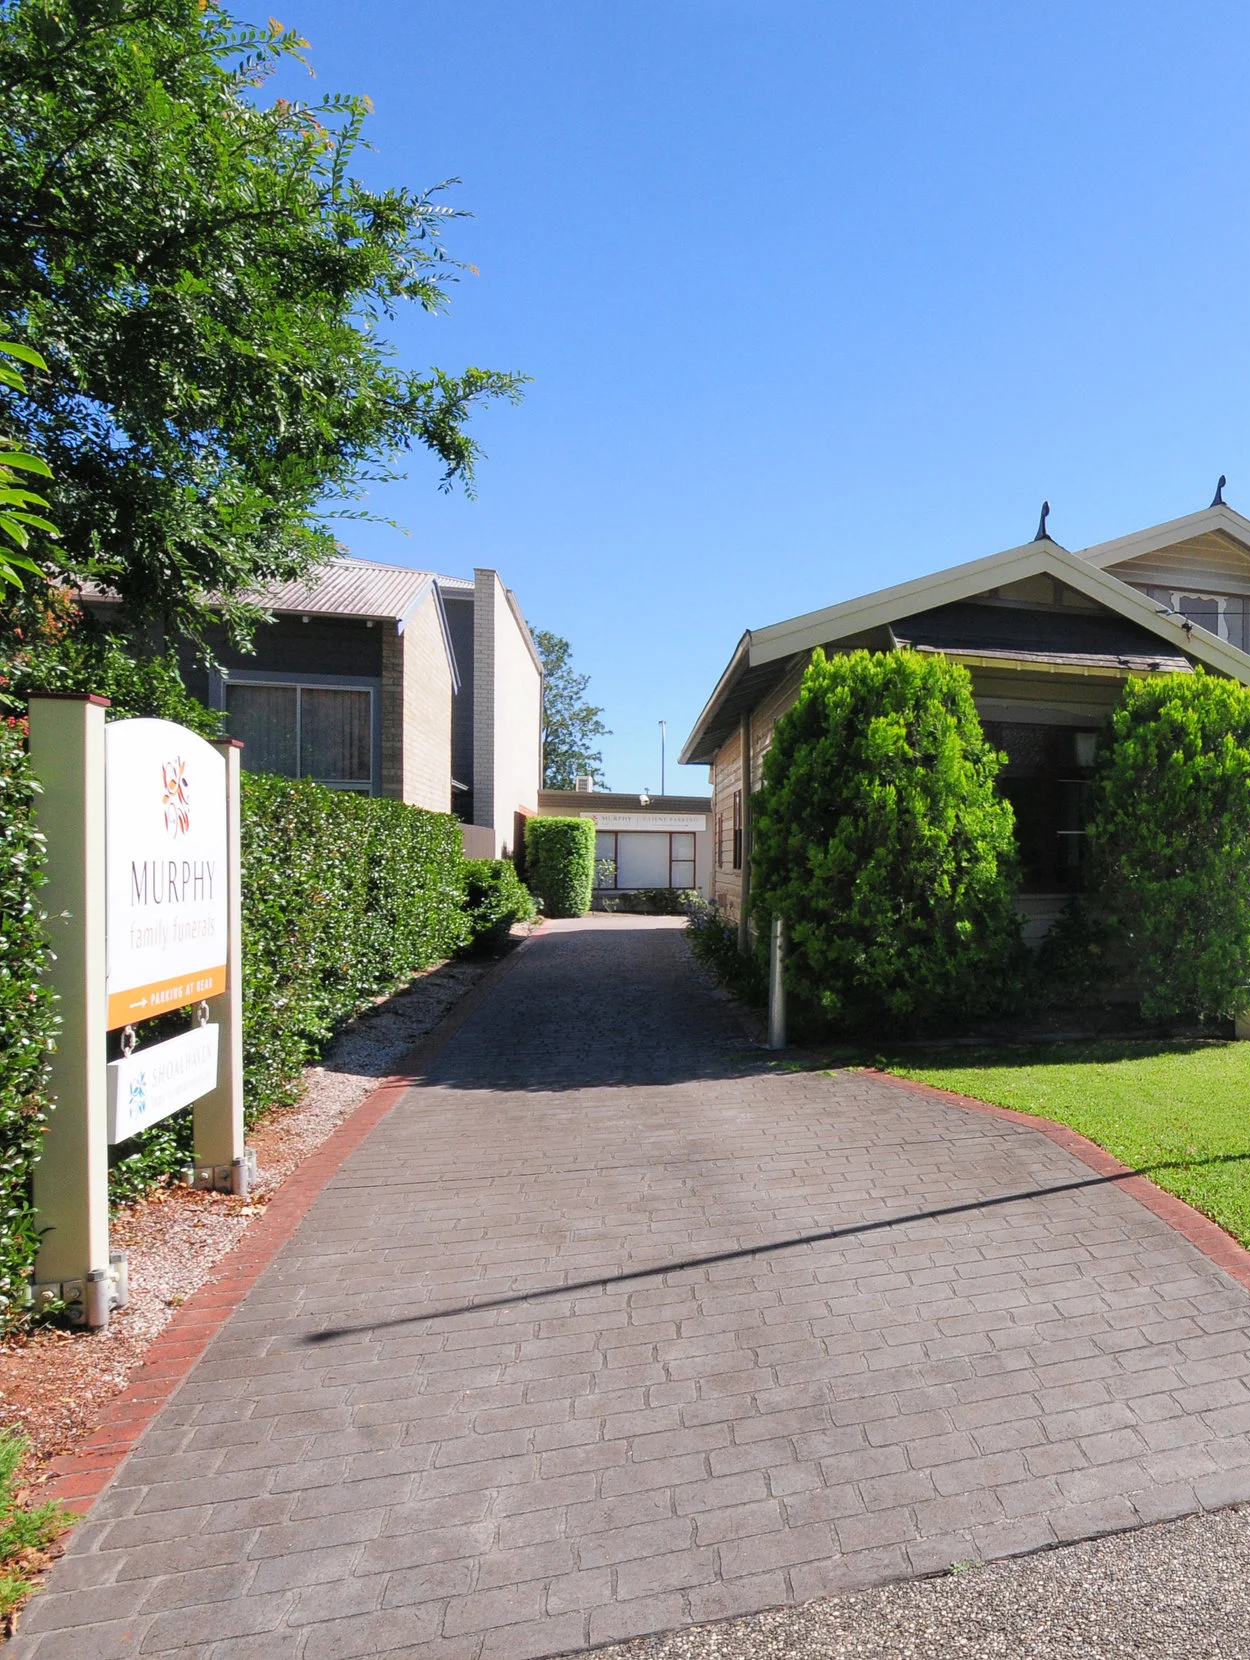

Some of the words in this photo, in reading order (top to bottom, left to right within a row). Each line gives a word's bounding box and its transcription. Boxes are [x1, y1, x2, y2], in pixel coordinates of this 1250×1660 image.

[131, 860, 215, 907] MURPHY
[130, 918, 168, 952] family
[173, 913, 215, 942] funerals
[150, 985, 183, 1006] PARKING
[185, 982, 194, 996] AT
[196, 977, 213, 992] REAR
[151, 1043, 213, 1087] SHOALHAVEN
